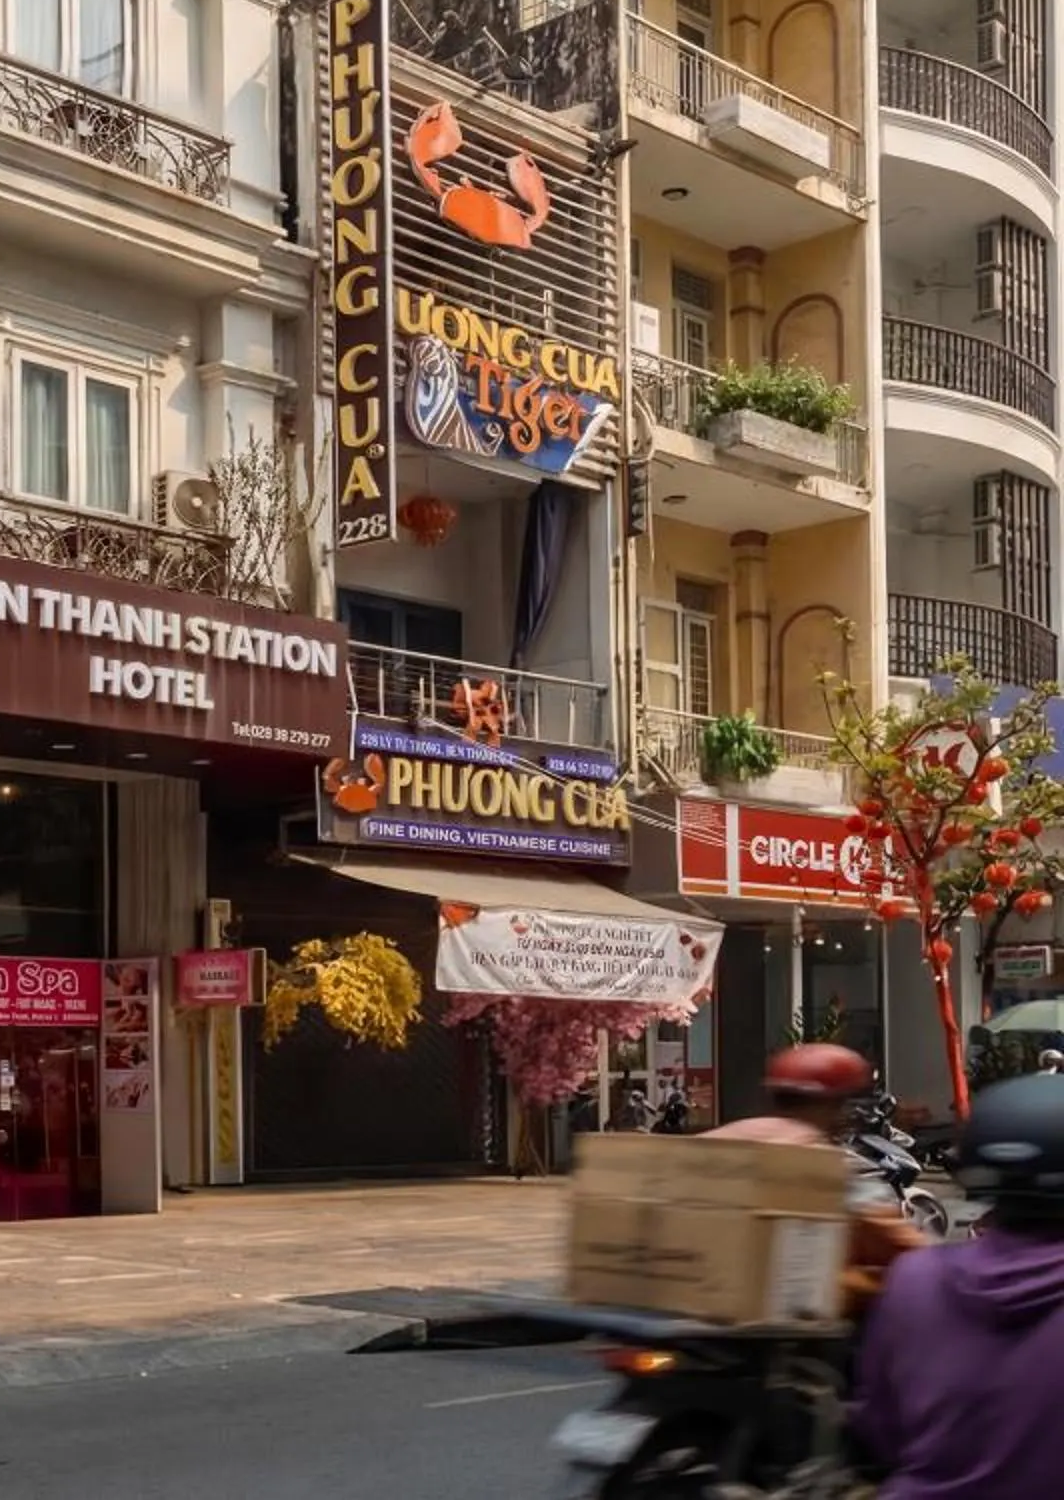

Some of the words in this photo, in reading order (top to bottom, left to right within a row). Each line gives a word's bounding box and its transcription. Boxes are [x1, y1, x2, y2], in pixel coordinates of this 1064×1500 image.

[397, 289, 531, 369] ƯƠNG
[541, 343, 620, 400] CUA
[338, 344, 381, 505] CUA
[466, 355, 588, 452] Tiger
[338, 513, 387, 545] 228
[32, 587, 181, 650] THANH
[184, 617, 336, 677] STATION
[89, 656, 214, 710] HOTEL
[289, 729, 309, 745] 279
[388, 757, 556, 821] PHƯƠNG
[563, 779, 632, 831] CUA
[369, 821, 405, 838] FINE
[468, 831, 556, 851] VIETNAMESE
[559, 839, 612, 856] CUISINE
[750, 835, 835, 872] CIRCLE
[17, 961, 79, 995] Spa
